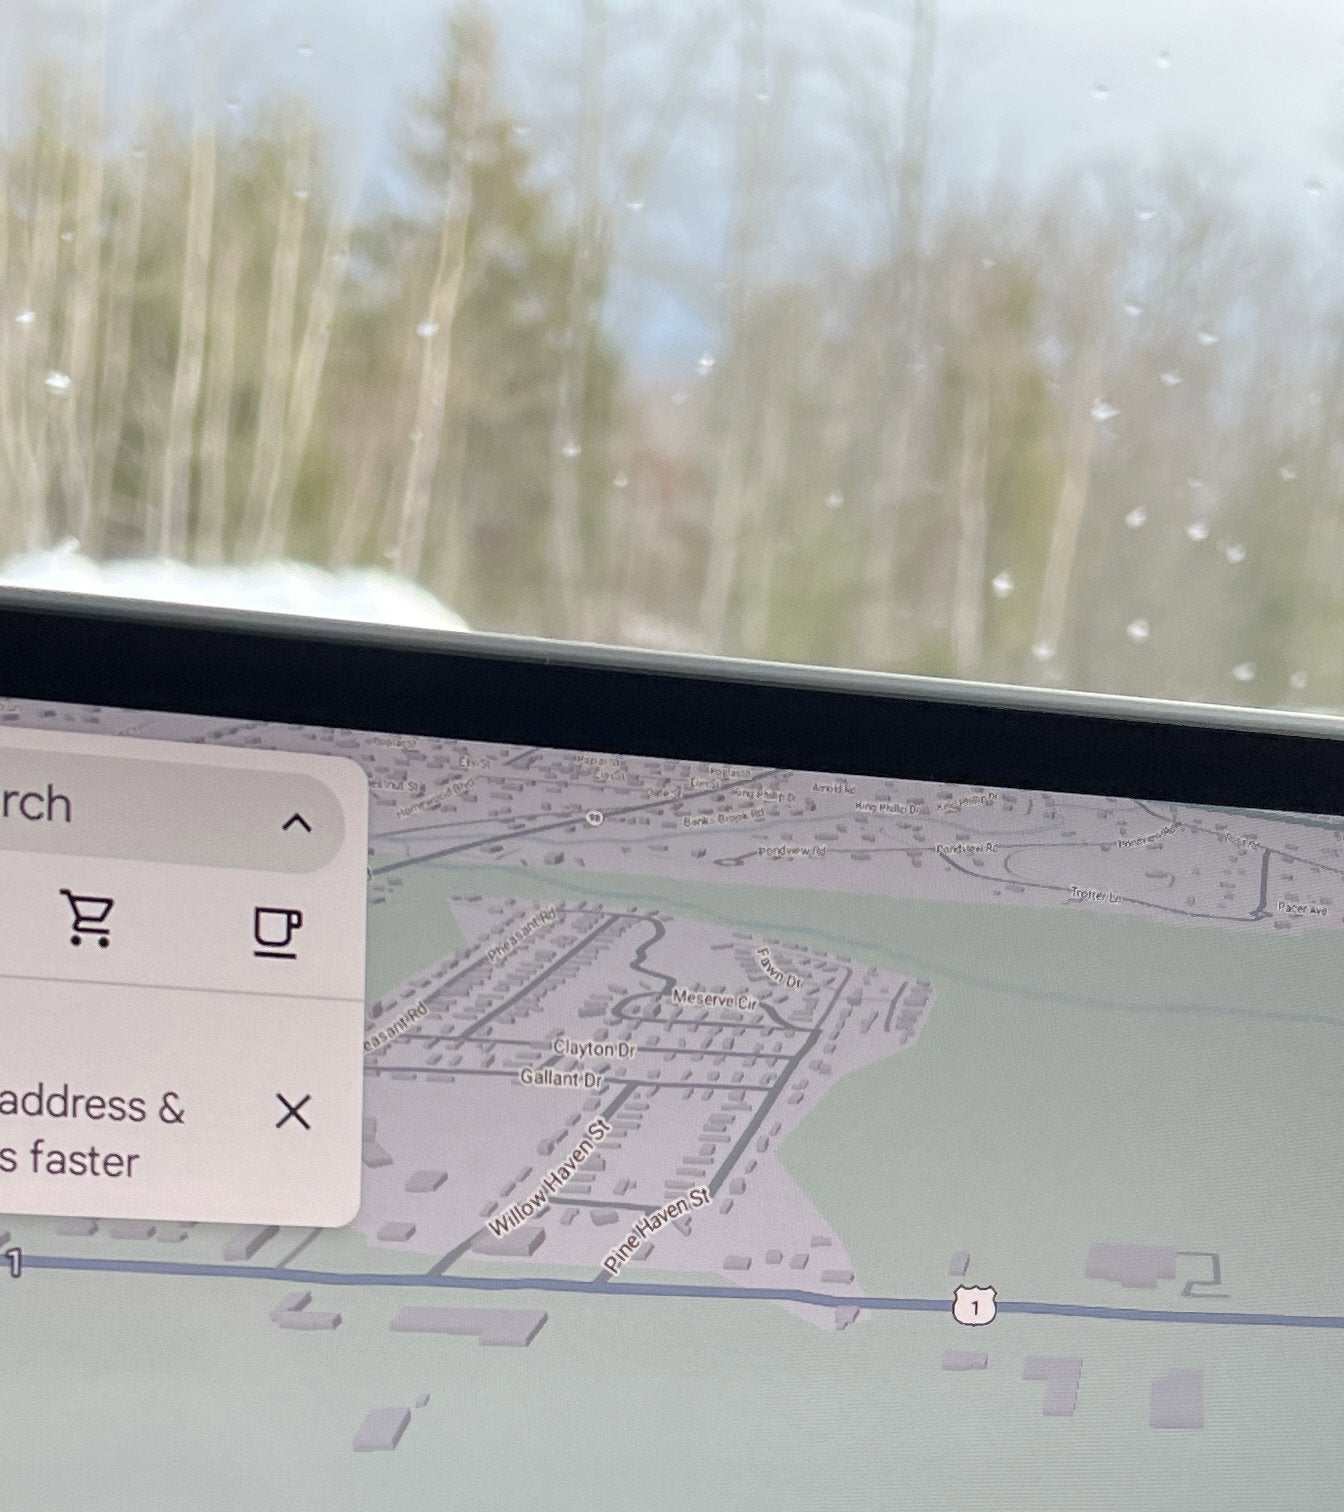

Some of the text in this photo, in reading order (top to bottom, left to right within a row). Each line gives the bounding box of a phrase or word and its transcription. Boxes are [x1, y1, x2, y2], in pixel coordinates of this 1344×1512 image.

[855, 801, 877, 814] King
[1071, 886, 1109, 903] Trotter
[1278, 901, 1327, 917] Pacer Ave
[487, 906, 557, 962] Pheasant Rd
[757, 947, 802, 989] Fawn Dr
[672, 988, 757, 1011] Meserve Cir
[406, 1000, 429, 1023] Rd
[553, 1037, 637, 1059] Clayton Dr
[519, 1067, 603, 1088] Gallant Dr
[158, 1090, 186, 1125] &
[29, 1137, 141, 1178] faster
[487, 1118, 611, 1237] Willow Haven St
[603, 1185, 712, 1275] Pine Haven St
[4, 1245, 25, 1278] 1
[971, 1300, 979, 1316] 1
